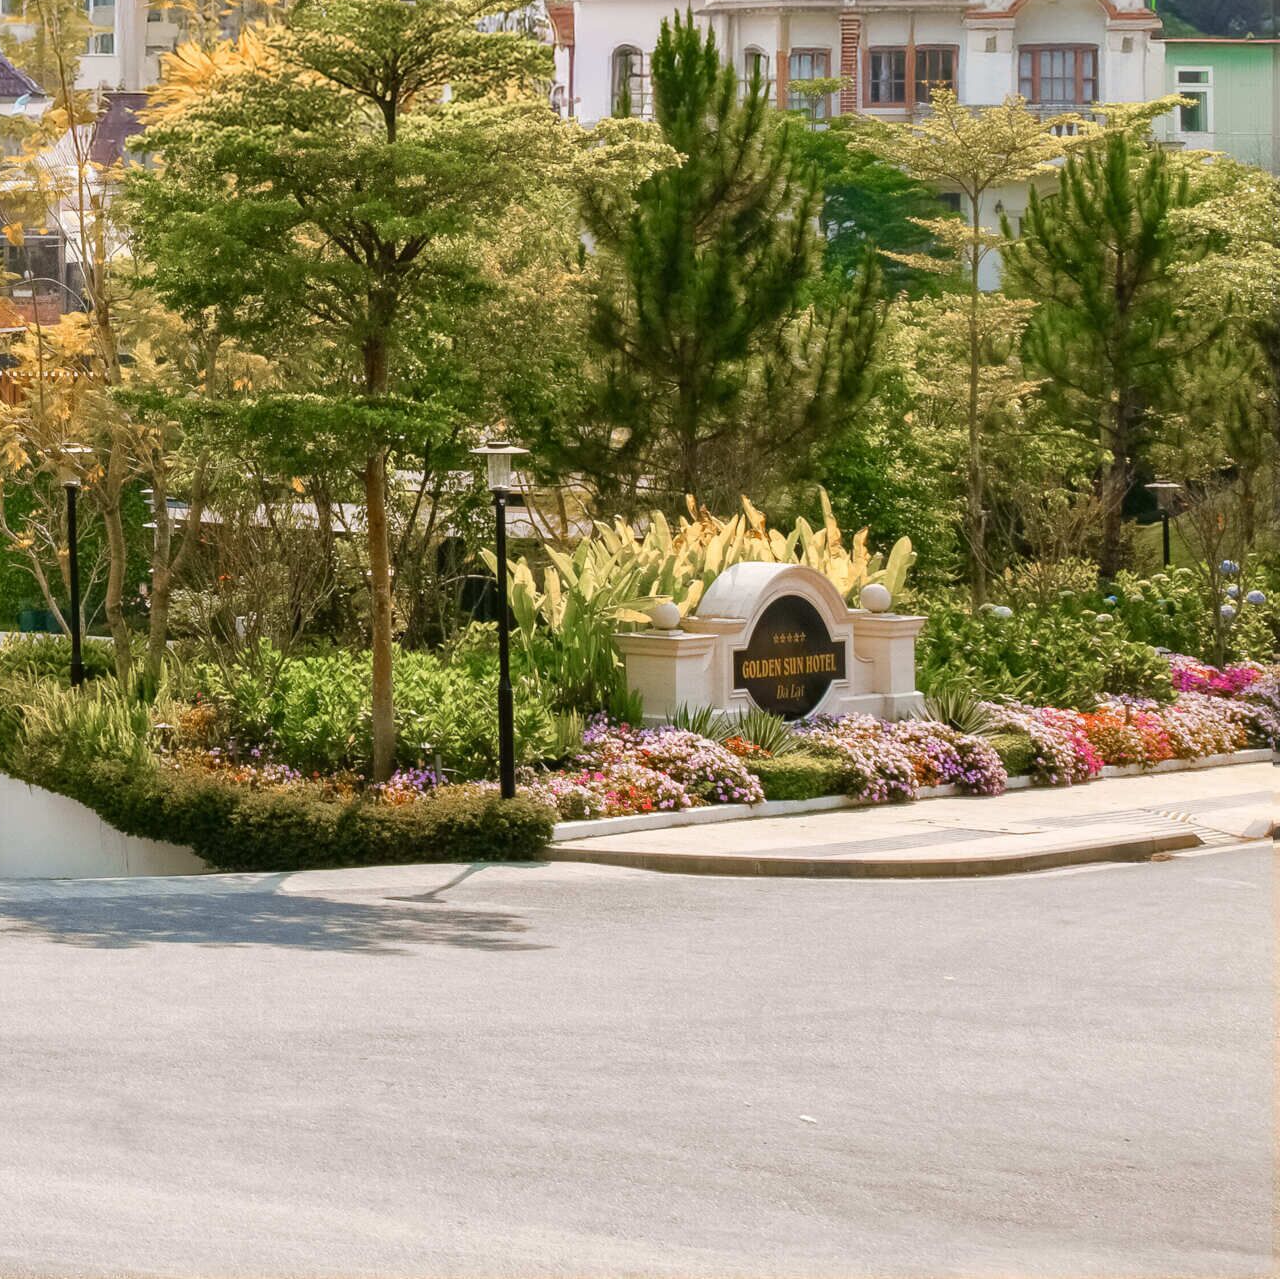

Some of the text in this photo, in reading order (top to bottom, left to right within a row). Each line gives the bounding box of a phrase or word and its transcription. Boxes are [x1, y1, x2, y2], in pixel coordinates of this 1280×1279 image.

[742, 653, 837, 679] GOLDEN SUN HOTEL
